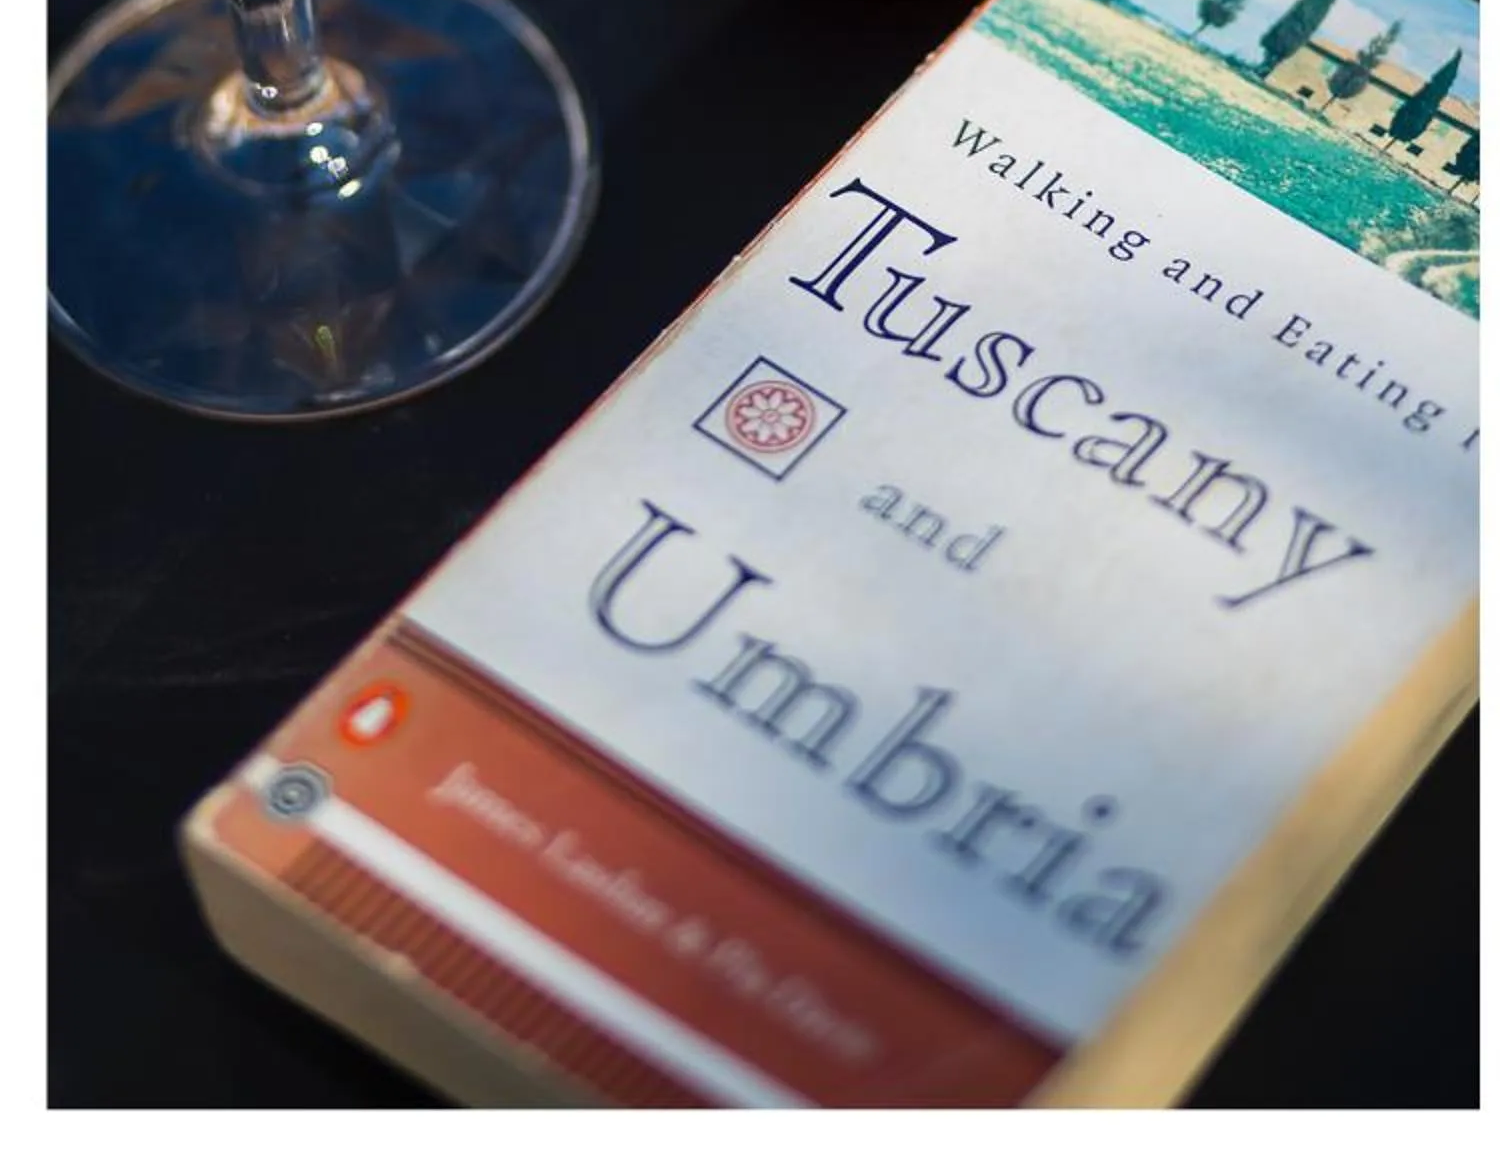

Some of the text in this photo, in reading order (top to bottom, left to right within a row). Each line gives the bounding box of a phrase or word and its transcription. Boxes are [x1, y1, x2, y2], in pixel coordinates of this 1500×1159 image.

[789, 177, 1376, 609] Tuscany
[951, 118, 1150, 262] Walking
[1161, 257, 1264, 320] and
[1271, 313, 1447, 433] Eating
[858, 482, 1008, 572] and
[588, 498, 1170, 959] Umbria
